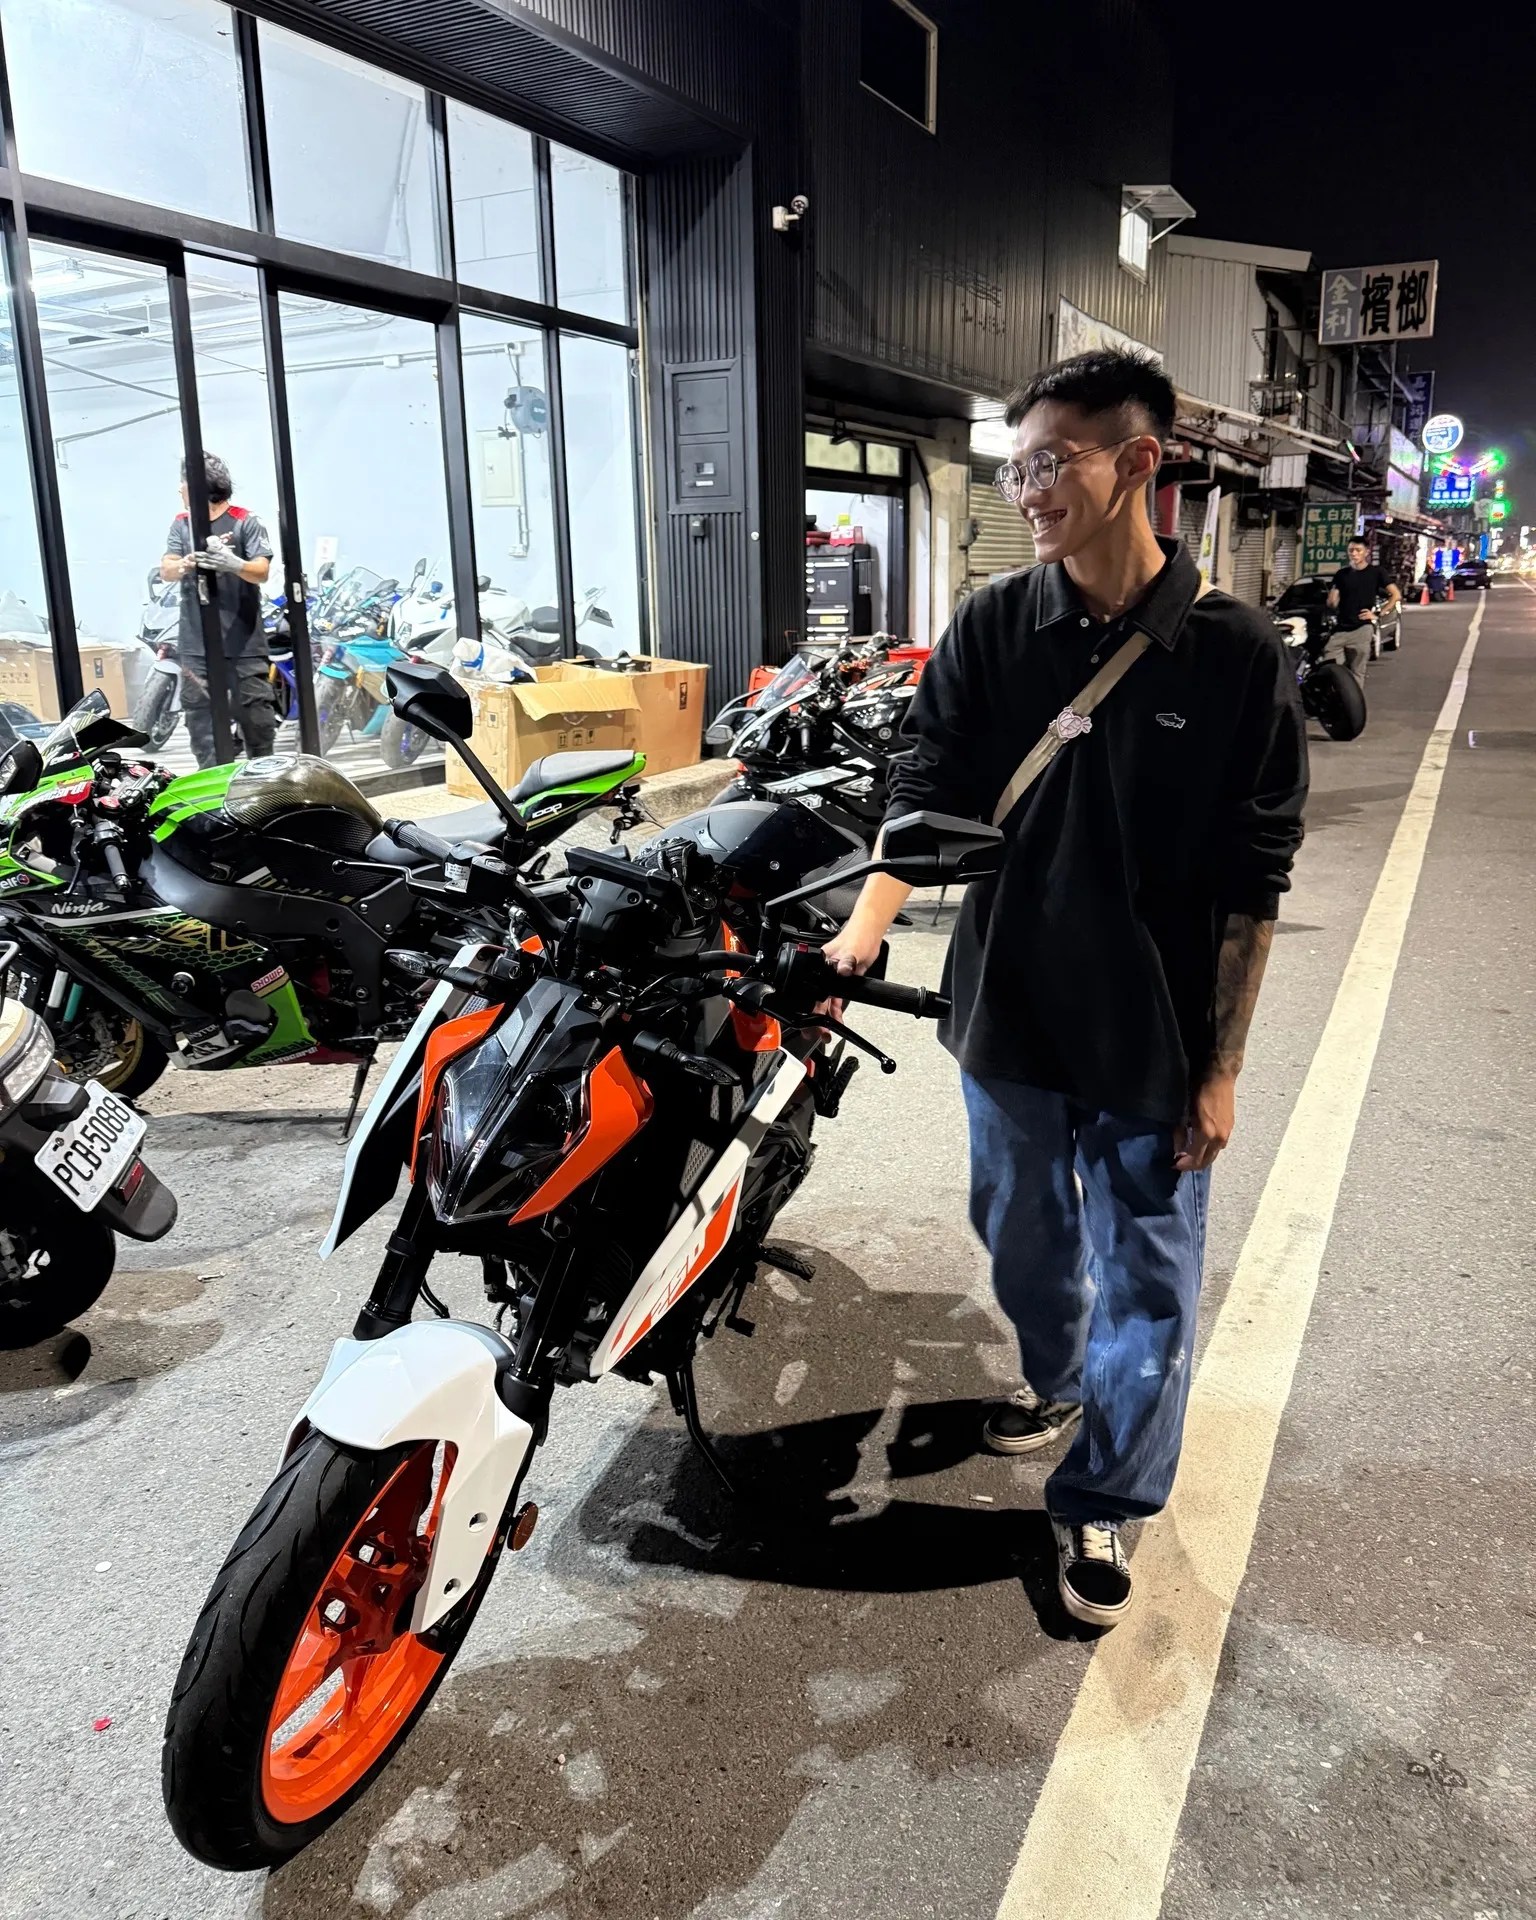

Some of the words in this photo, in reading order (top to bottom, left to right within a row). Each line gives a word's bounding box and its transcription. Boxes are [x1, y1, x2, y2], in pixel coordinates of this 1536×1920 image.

[1361, 269, 1429, 336] 檳榔
[0, 877, 18, 889] elf
[51, 901, 110, 917] Ninja
[251, 966, 284, 991] SHOWA
